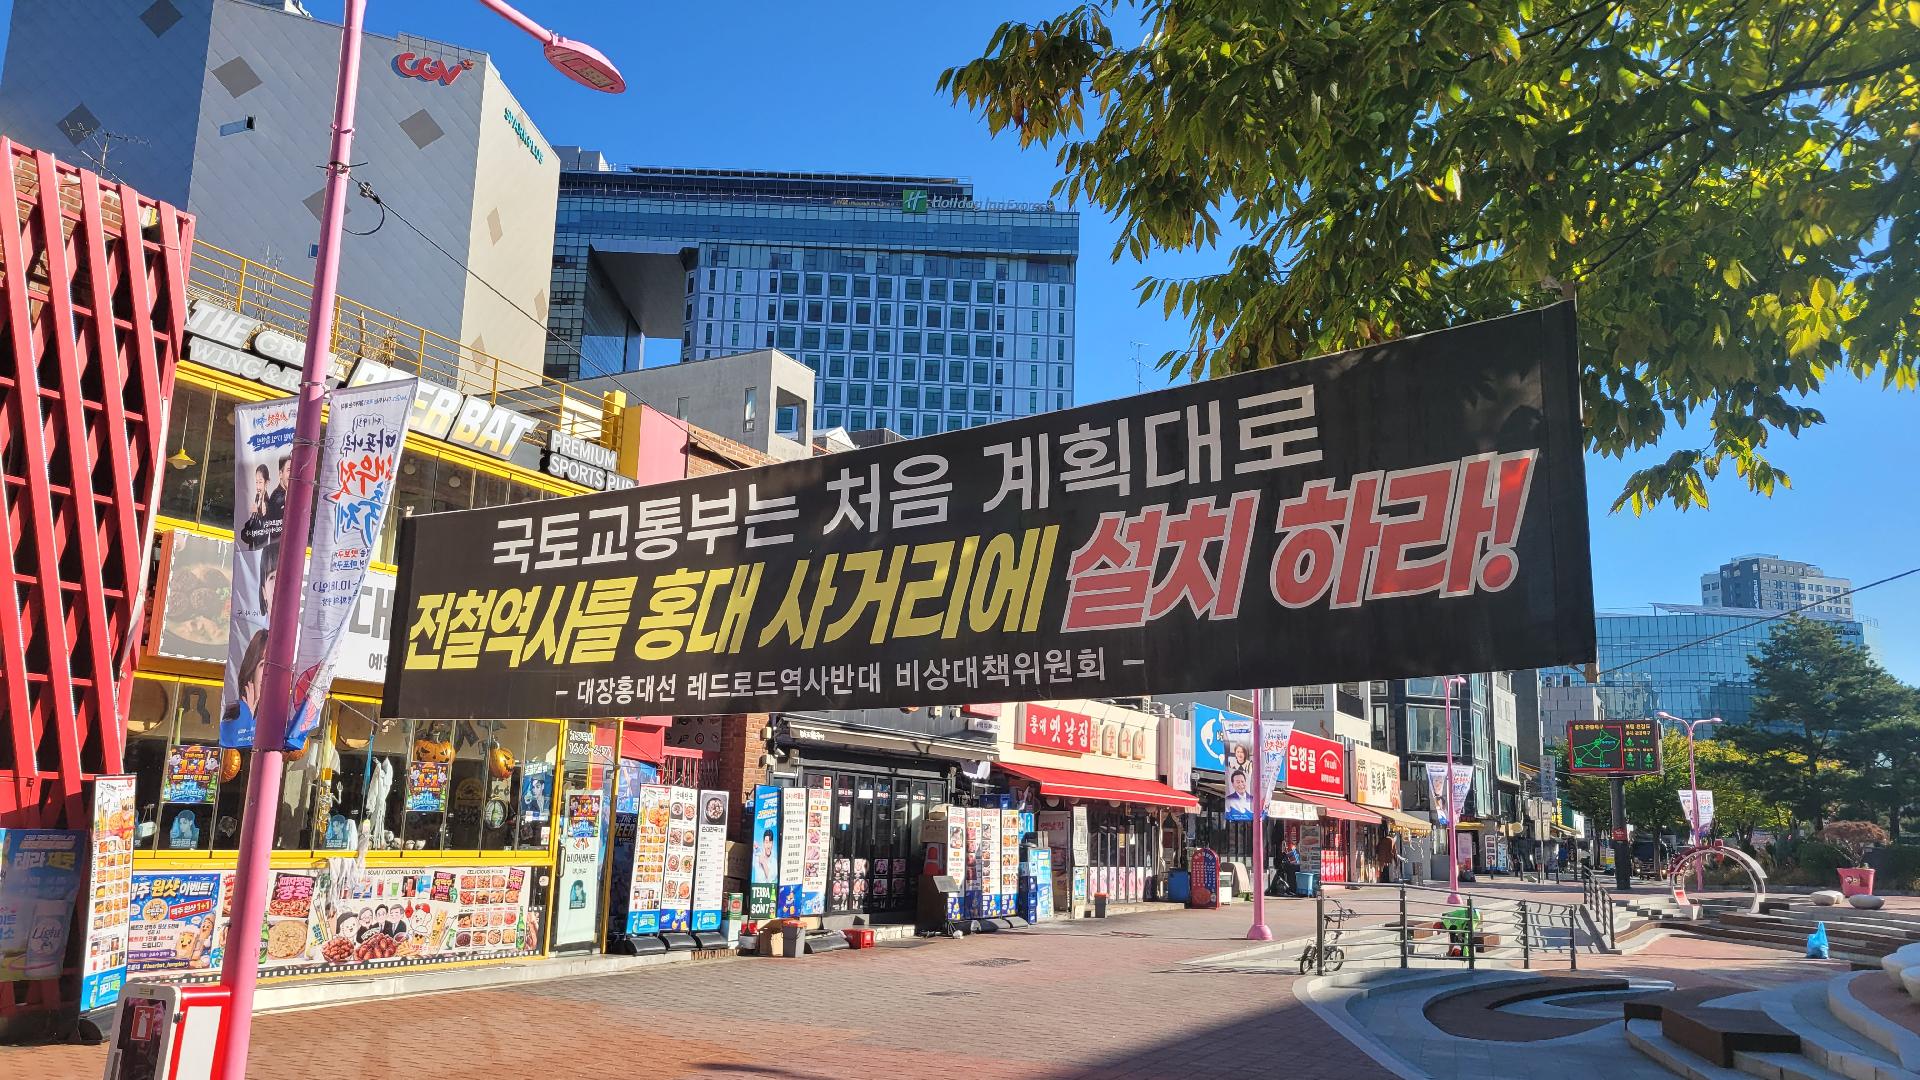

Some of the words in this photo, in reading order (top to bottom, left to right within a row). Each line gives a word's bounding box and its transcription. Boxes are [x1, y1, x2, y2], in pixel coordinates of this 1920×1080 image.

[397, 52, 463, 86] CGV
[503, 107, 545, 165] SPARKPLUS
[932, 194, 983, 212] Holiday
[984, 198, 1005, 211] Inn
[190, 304, 253, 345] THE
[550, 436, 617, 471] PREMIUM
[493, 484, 800, 574] 국토교통부는
[823, 453, 953, 535] 처음
[983, 384, 1324, 513] 계획대로
[548, 457, 606, 488] SPORTS
[405, 575, 639, 670] 전철역사를
[634, 562, 765, 661] 홍대
[758, 524, 1061, 650] 사거리에
[1060, 489, 1261, 634] 설치
[1269, 448, 1539, 610] 하라!
[577, 673, 676, 705] 대장홍대선
[687, 662, 880, 701] 레드로드역사반대
[897, 647, 1105, 693] 비상대책위원회
[1029, 714, 1047, 736] 홍대
[1049, 714, 1089, 748] 옛날집
[1289, 745, 1316, 774] 은행골
[152, 879, 180, 897] 원샷
[180, 881, 215, 896] 이벤트!
[752, 886, 770, 899] TERRA
[32, 924, 62, 942] Light
